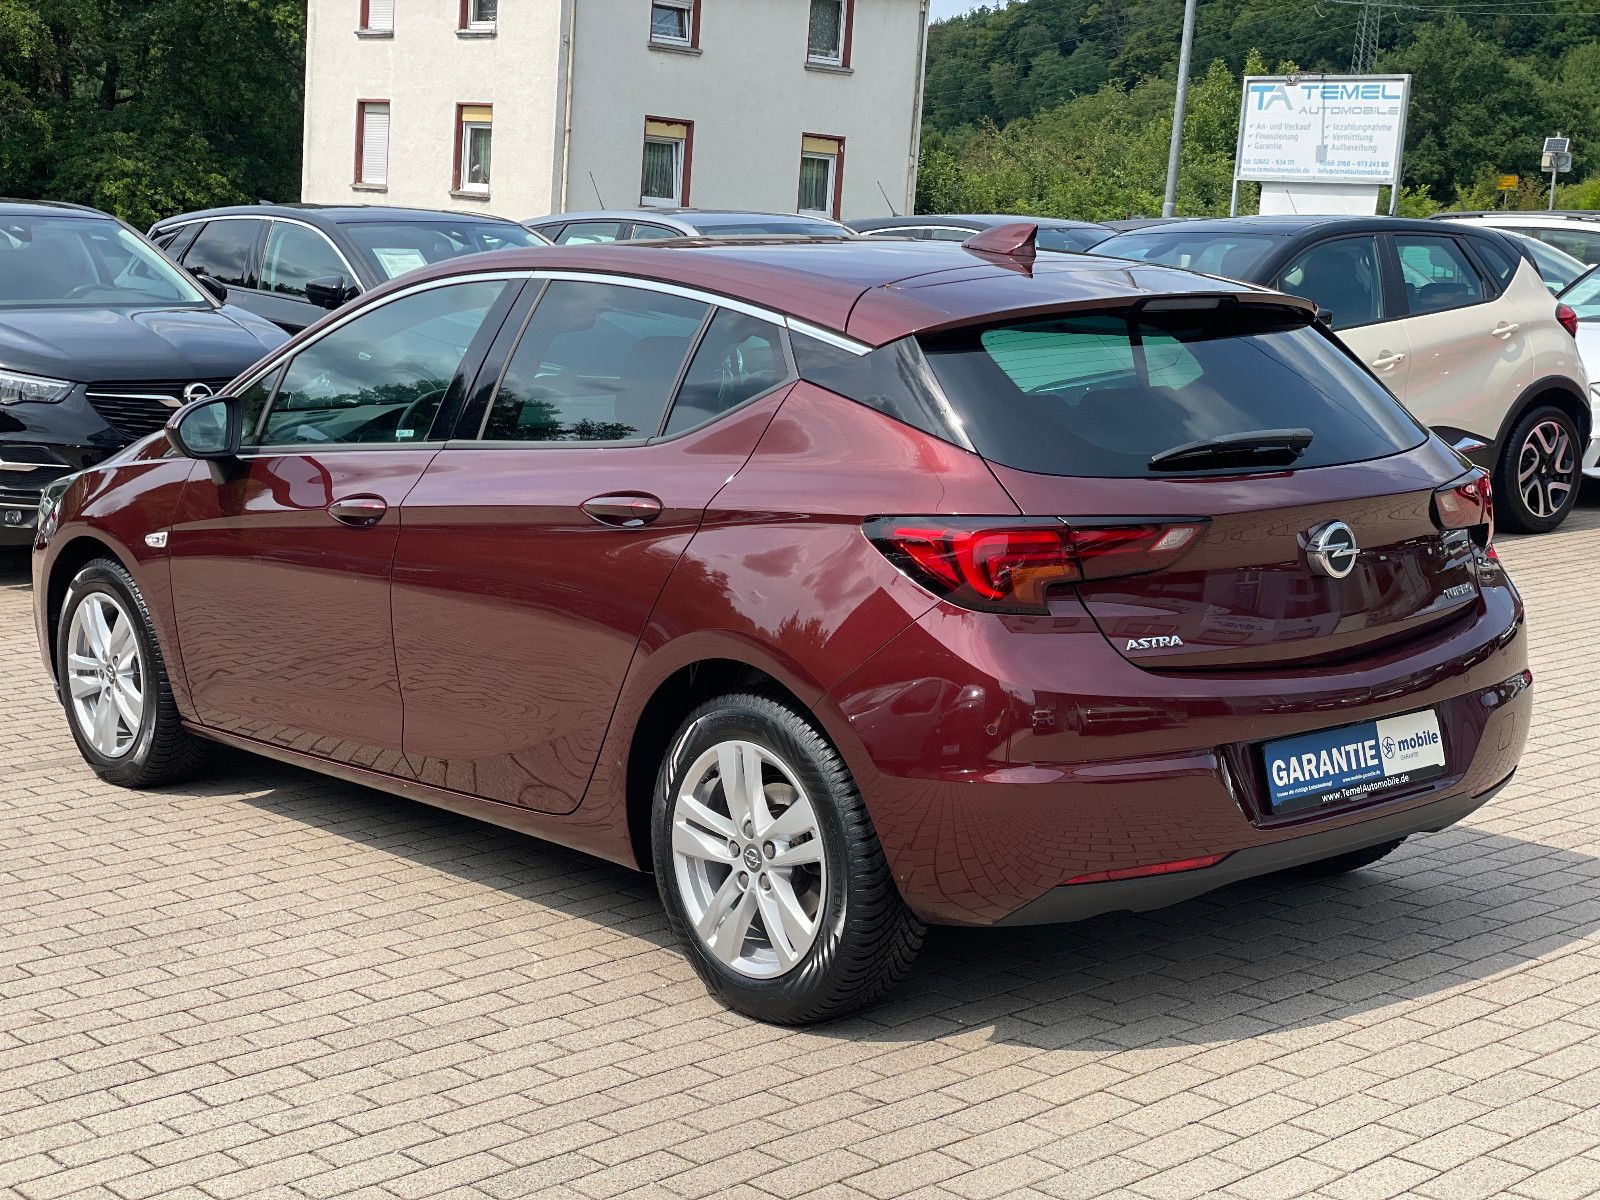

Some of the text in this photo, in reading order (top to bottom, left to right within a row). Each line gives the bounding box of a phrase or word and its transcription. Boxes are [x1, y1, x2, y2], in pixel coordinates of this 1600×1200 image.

[1301, 84, 1400, 100] TEMEL
[1299, 106, 1399, 115] AUTOMOBILE
[1284, 123, 1312, 131] Verkauf
[1333, 123, 1393, 132] Inzahlungnahme
[1255, 133, 1299, 142] Finanzierung
[1332, 133, 1374, 143] Vermittlung
[1330, 143, 1377, 153] Aufbereitung
[1242, 166, 1310, 174] www.temelautomobile.de
[1318, 167, 1391, 176] info@temelautomobile.de
[1126, 635, 1184, 650] ASTRA
[1397, 729, 1439, 751] mobile
[1272, 739, 1379, 786] GARANTIE
[1321, 773, 1409, 803] www.TemelAutomobile.de
